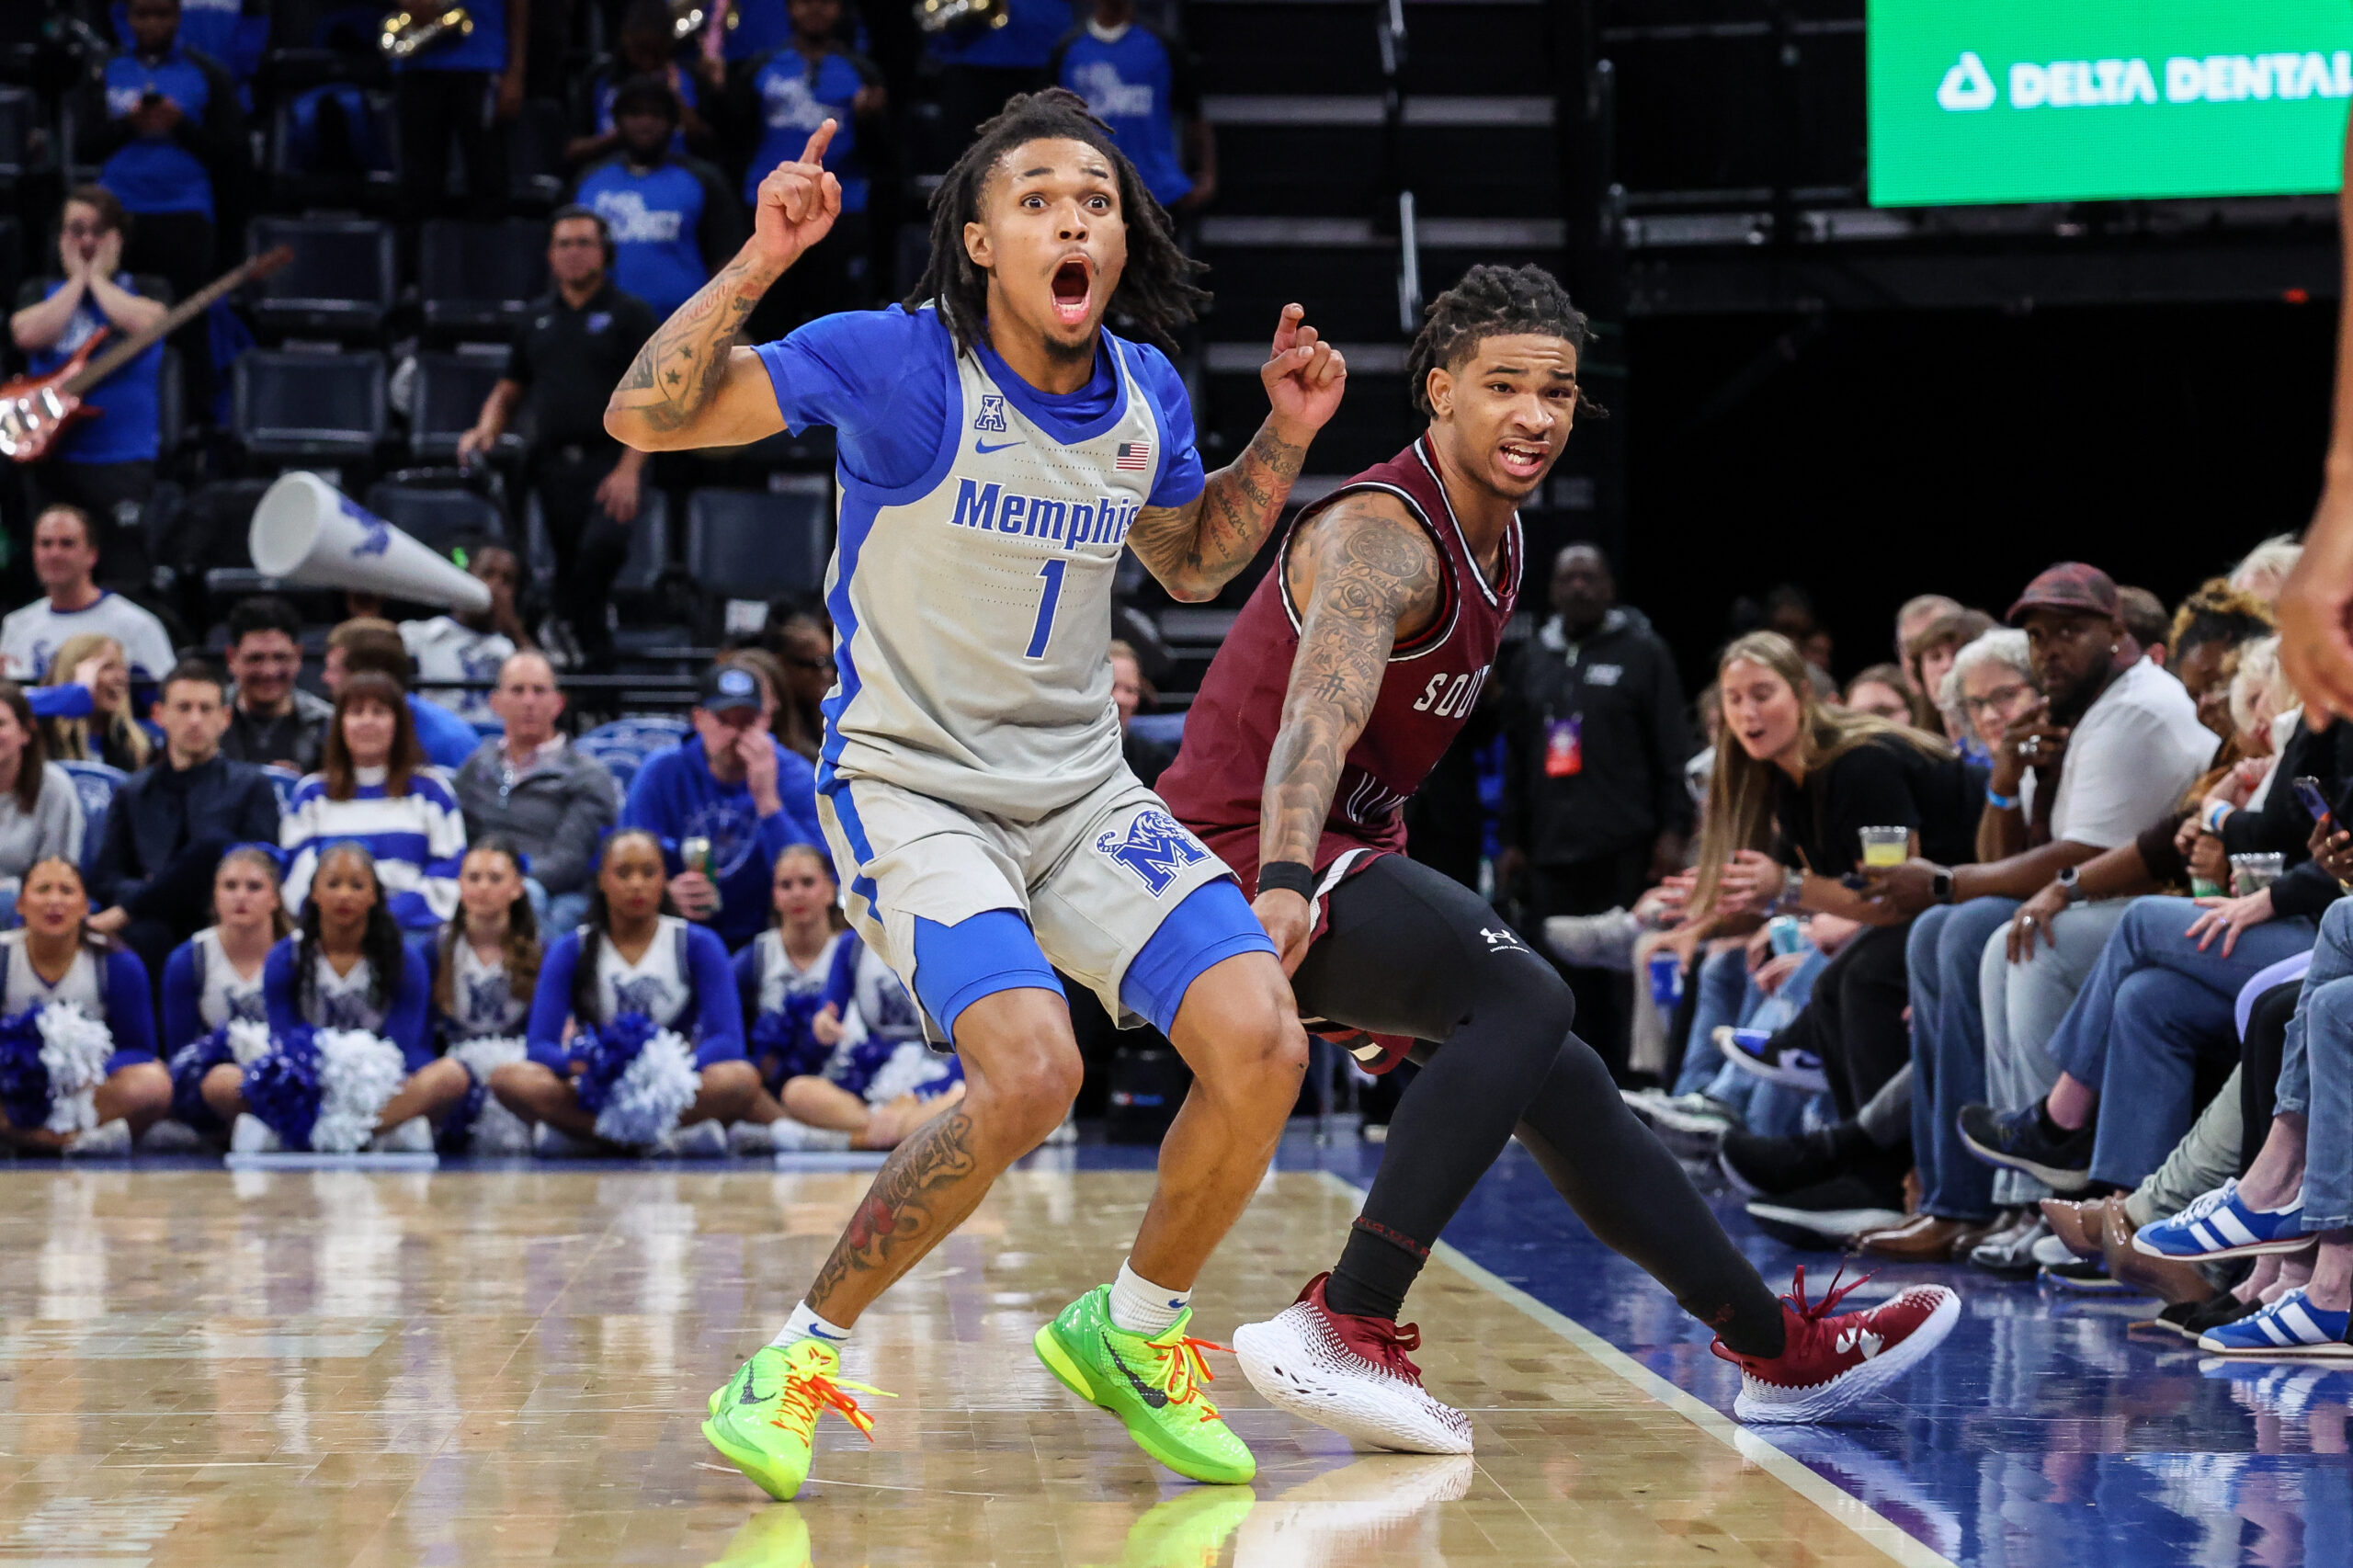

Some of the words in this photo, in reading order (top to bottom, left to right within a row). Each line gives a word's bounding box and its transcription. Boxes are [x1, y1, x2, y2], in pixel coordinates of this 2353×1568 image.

[2007, 57, 2158, 109] DELTA
[2165, 51, 2353, 104] DENTAL
[1023, 557, 1069, 660] 1
[1413, 665, 1491, 719] SOU
[1107, 832, 1213, 901] M
